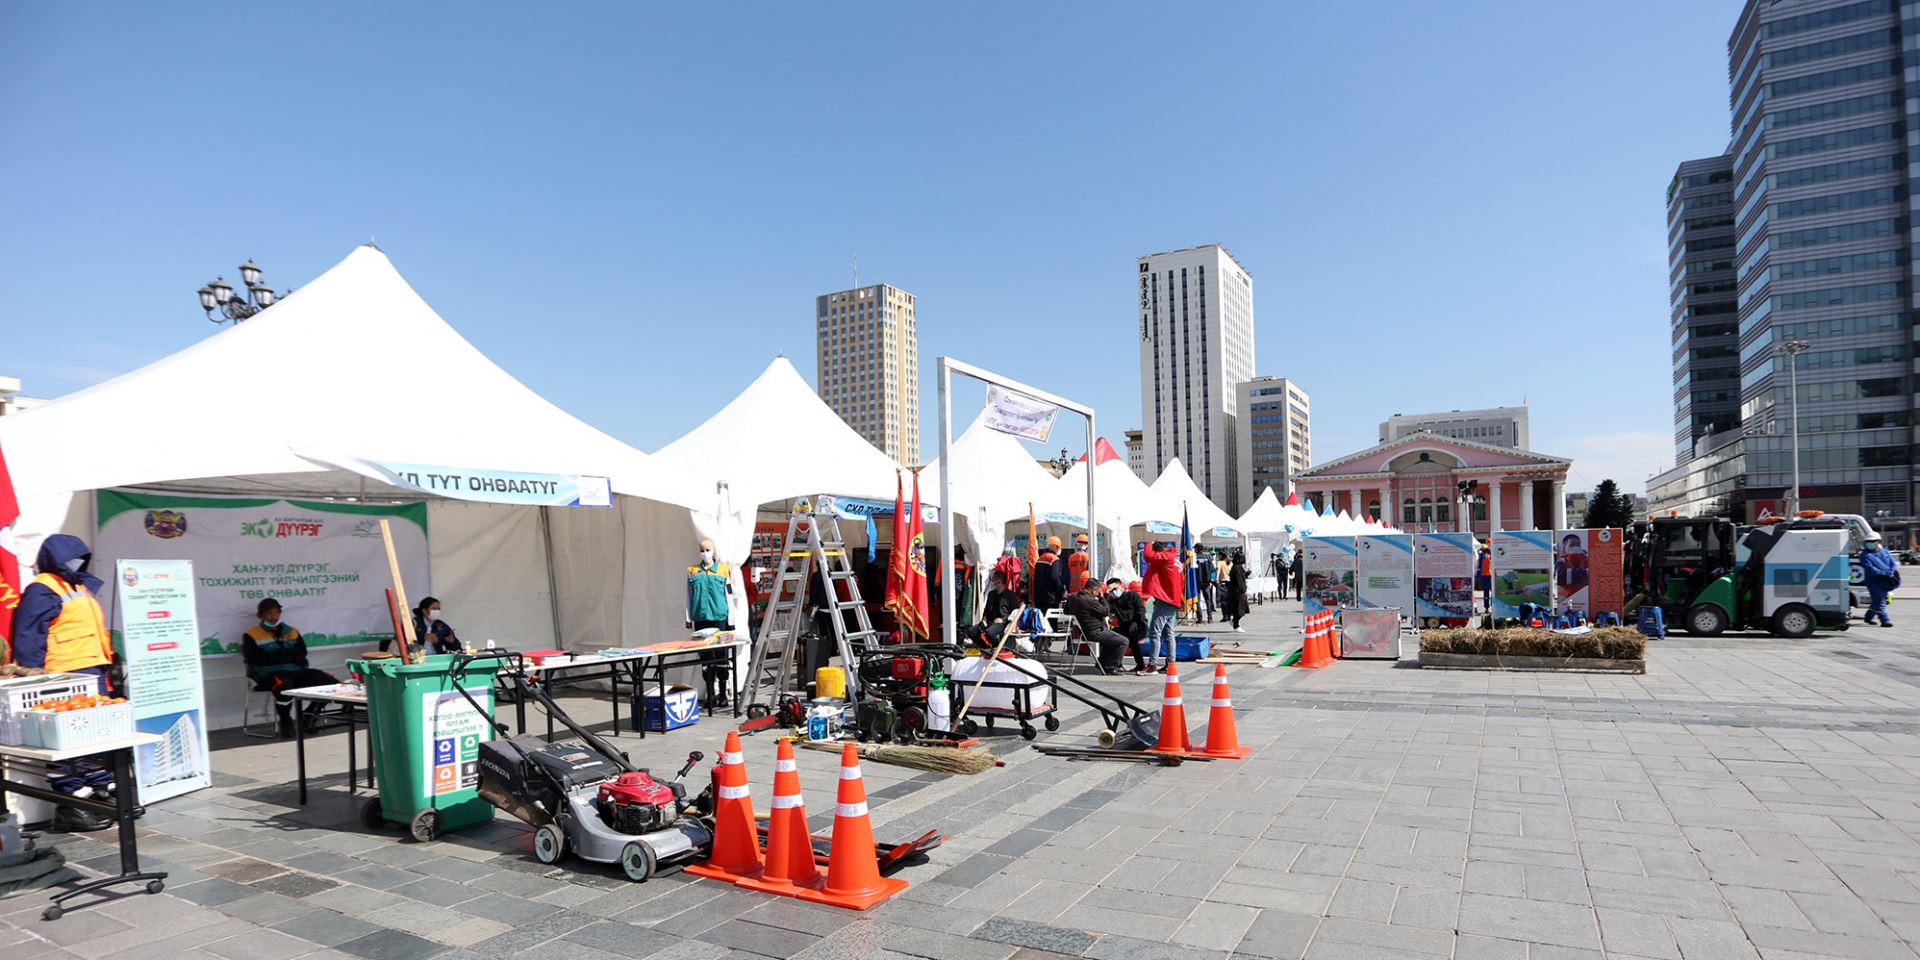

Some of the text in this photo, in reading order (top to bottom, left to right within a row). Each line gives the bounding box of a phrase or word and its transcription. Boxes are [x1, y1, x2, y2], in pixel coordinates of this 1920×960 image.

[426, 473, 462, 490] ТҮТ
[468, 476, 558, 495] ОНӨААТҮГ
[275, 522, 323, 538] ДҮҮРЭГ
[232, 563, 330, 574] ХАН-УУЛ ДҮҮРЭГ
[199, 572, 360, 587] ТОХИЖИЛТ ҮЙЛЧИЛГЭЭНИЙ
[238, 587, 328, 599] ТӨВ ОНӨААТҮГ
[480, 758, 511, 780] HONDA
